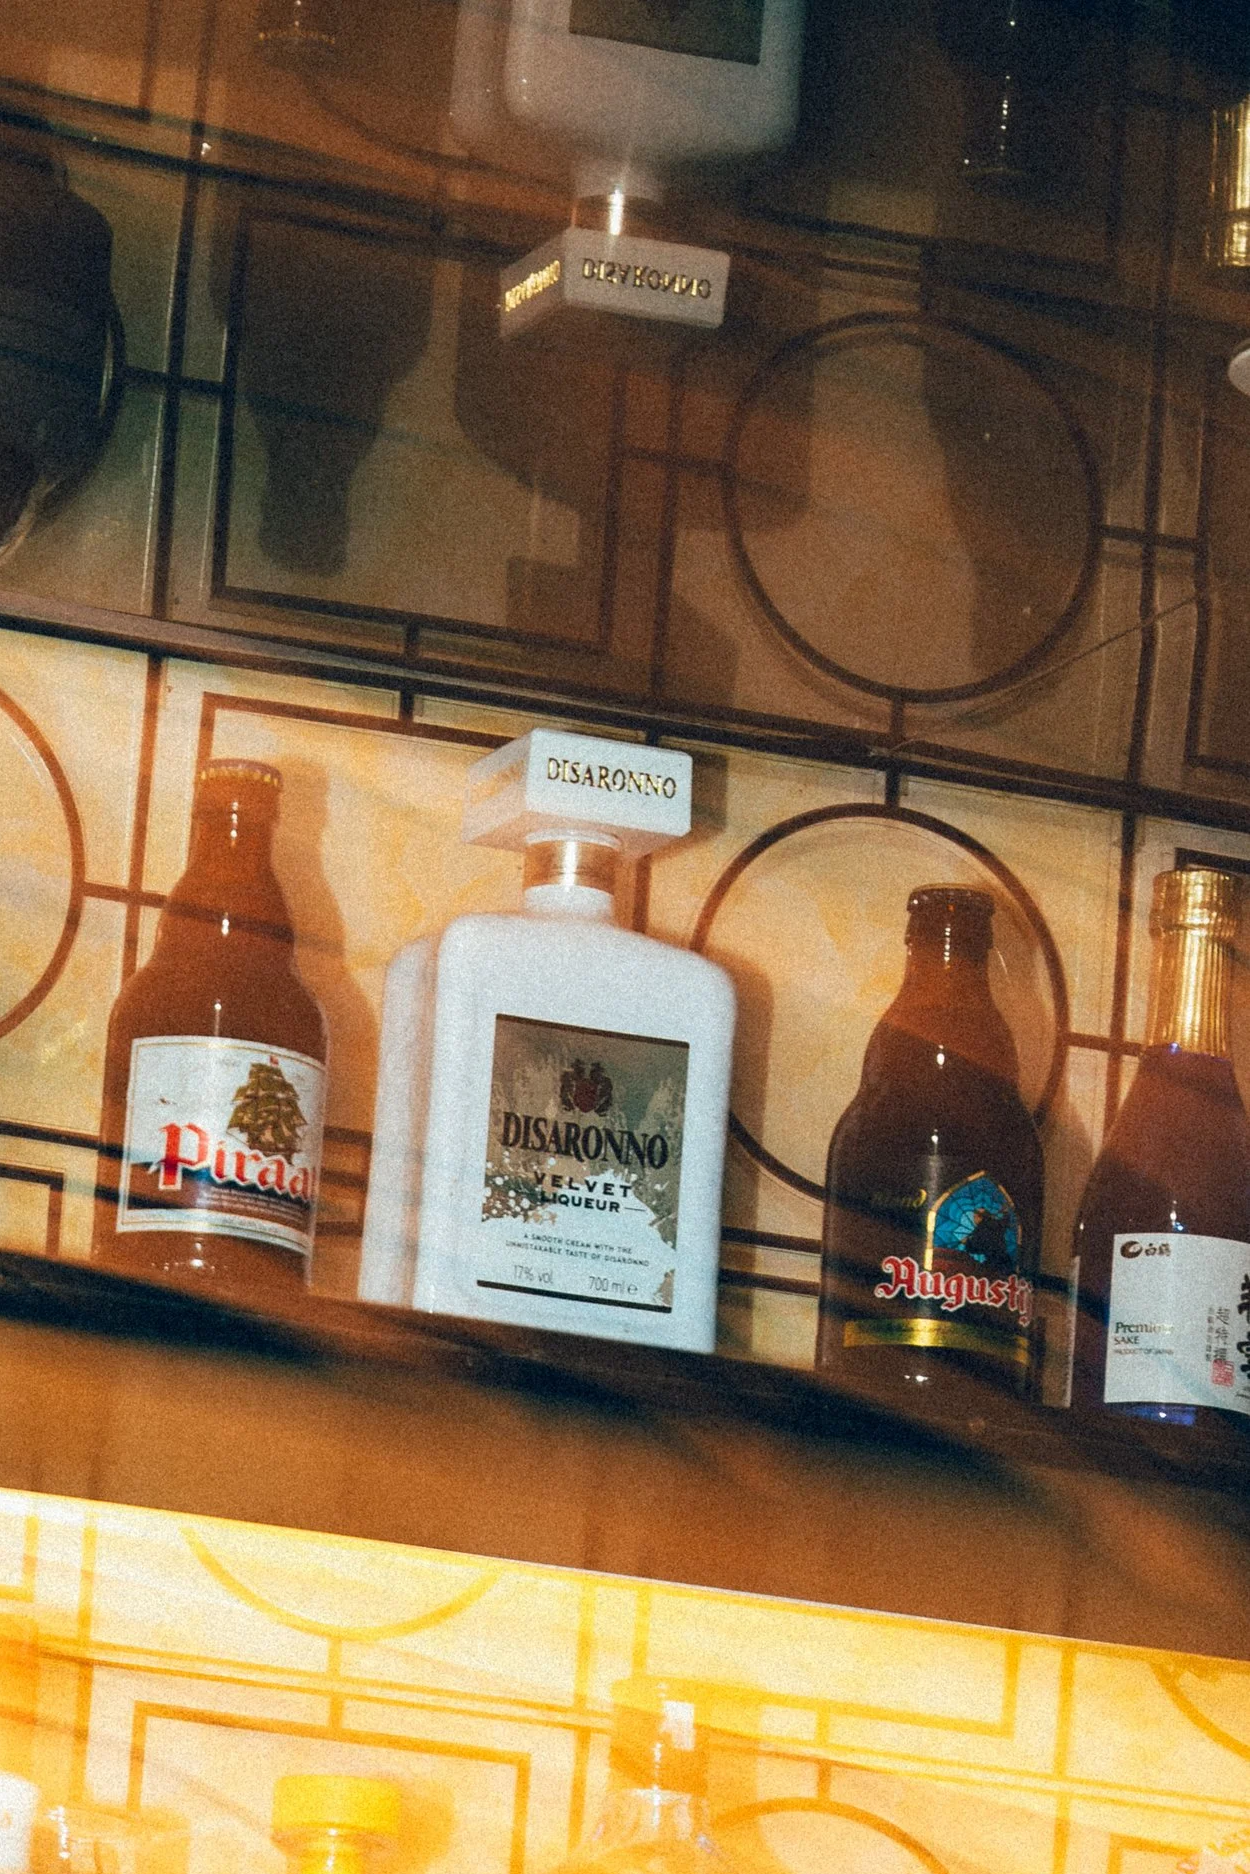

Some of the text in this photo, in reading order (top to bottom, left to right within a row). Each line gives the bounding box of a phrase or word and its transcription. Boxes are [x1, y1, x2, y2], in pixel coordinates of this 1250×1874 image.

[546, 756, 677, 800] DISARONNO
[501, 1111, 669, 1170] DISARONNO
[159, 1121, 318, 1201] Piraa
[534, 1170, 633, 1198] VELVET
[540, 1190, 621, 1214] LIQUEUR
[531, 1233, 563, 1246] SMOOTH
[617, 1245, 633, 1255] THE
[564, 1249, 588, 1260] TASTE
[513, 1264, 554, 1285] 17% vol
[588, 1275, 609, 1292] 700
[611, 1279, 625, 1296] ml
[1114, 1321, 1176, 1337] Premiu
[1113, 1335, 1140, 1346] SAKE
